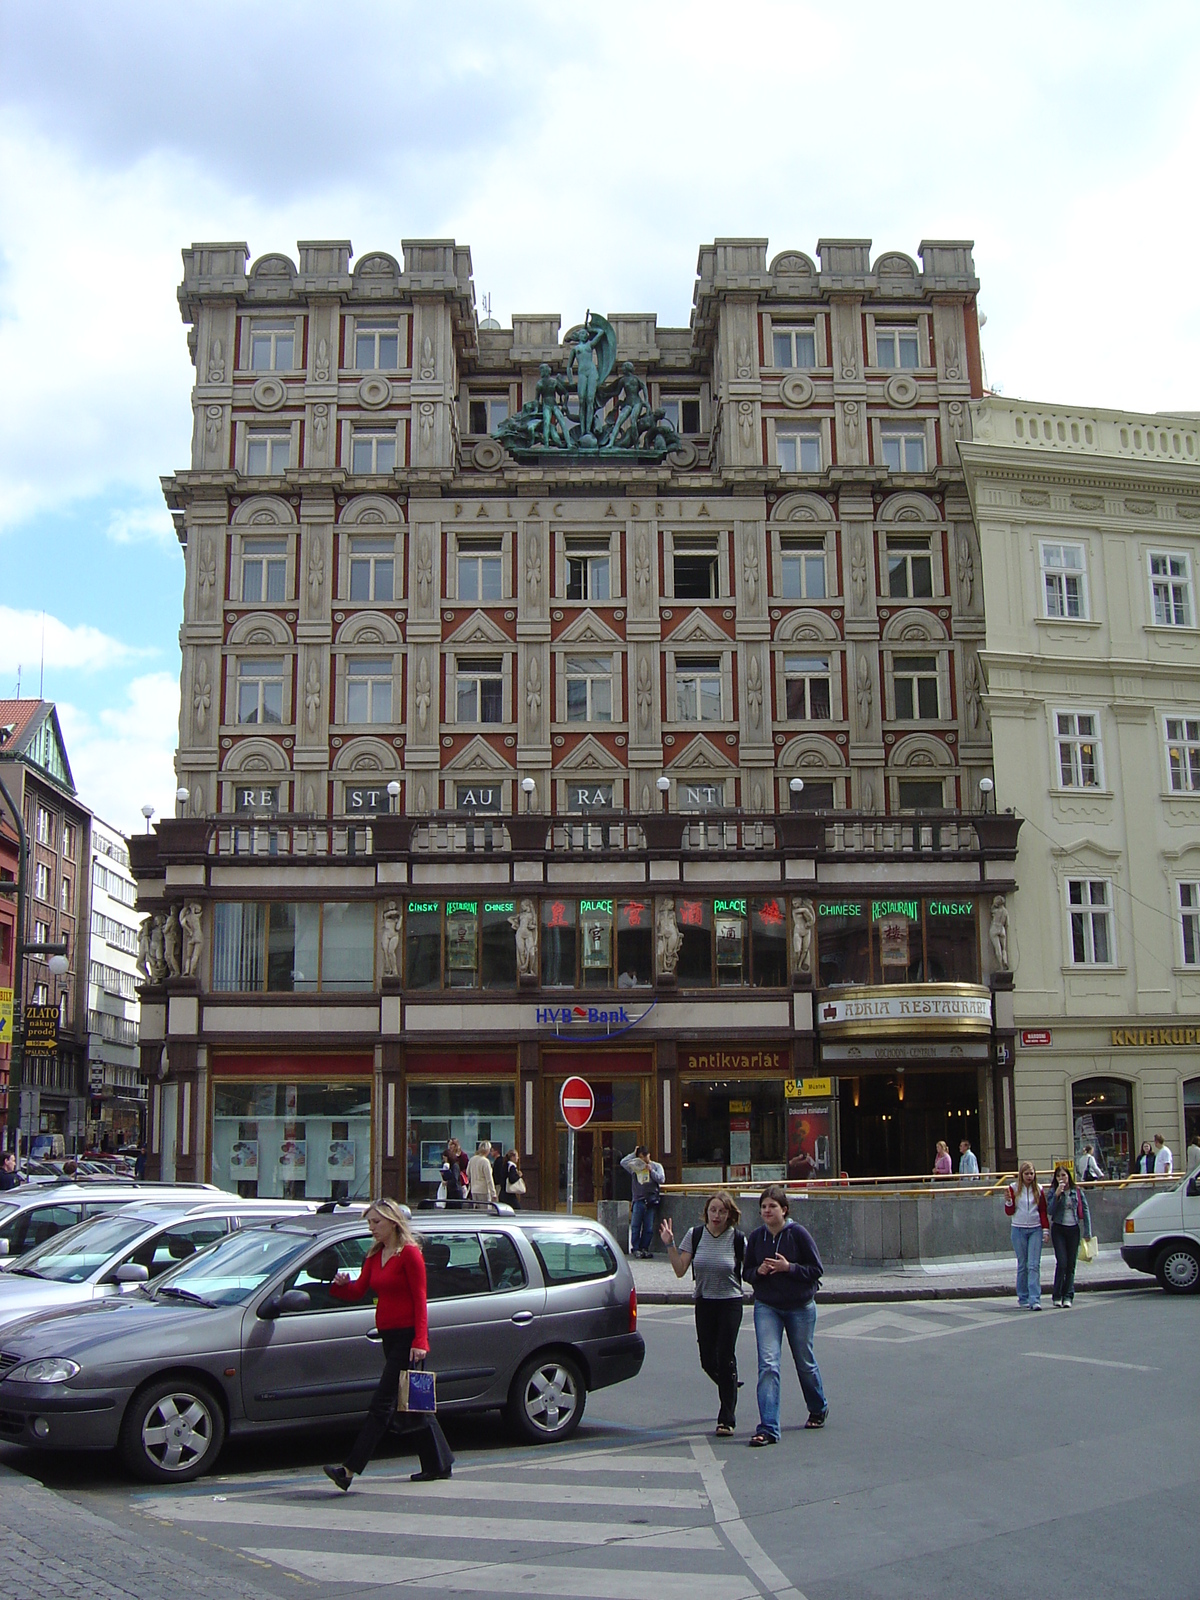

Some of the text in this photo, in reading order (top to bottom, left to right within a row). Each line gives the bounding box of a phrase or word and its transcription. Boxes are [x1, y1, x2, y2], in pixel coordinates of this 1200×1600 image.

[454, 501, 710, 518] PALÁC ADRIA
[243, 787, 716, 807] RE ST AU RA NT
[408, 902, 438, 912] ČÍNSKÝ
[484, 903, 514, 912] CHINESE
[580, 900, 613, 915] PALACE
[714, 900, 747, 915] PALACE
[818, 901, 973, 922] CHINESE RESTAURANT ČÍNSKÝ
[26, 1007, 59, 1018] ZLATO
[535, 1006, 630, 1023] HVB Bank
[845, 1000, 986, 1016] ADRIA RESTAURANT
[29, 1019, 55, 1029] nákup
[28, 1028, 56, 1037] prodej
[688, 1051, 780, 1068] antikvariát
[797, 1080, 802, 1088] A
